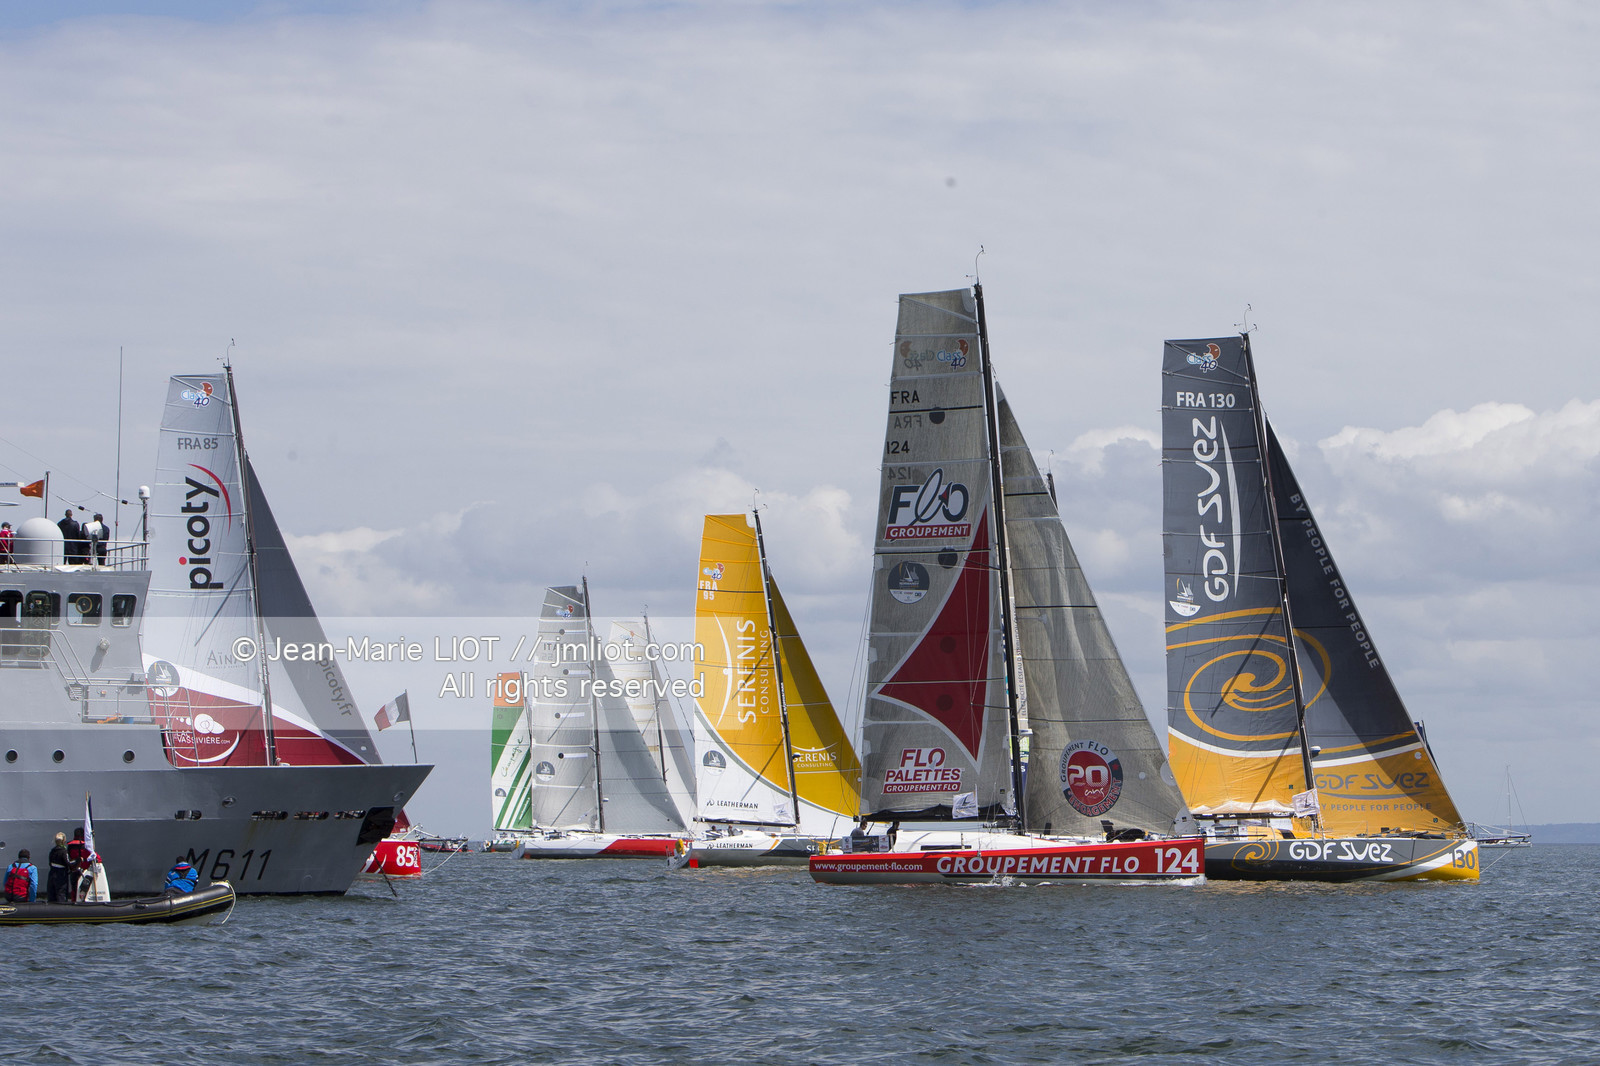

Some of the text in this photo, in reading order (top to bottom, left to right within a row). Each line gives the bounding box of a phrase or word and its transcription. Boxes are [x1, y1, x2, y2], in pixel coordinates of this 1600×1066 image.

[936, 350, 961, 361] Class
[951, 357, 967, 370] 40
[1200, 360, 1217, 372] 40
[181, 389, 205, 400] Class
[891, 391, 920, 404] FRA
[1176, 391, 1235, 408] FRA 130
[194, 397, 210, 408] 40
[177, 437, 218, 450] FRA 85
[886, 441, 910, 454] 124
[178, 476, 224, 590] picoty
[889, 526, 968, 537] GROUPEMENT
[700, 580, 718, 590] FRA
[1290, 493, 1380, 668] BY PEOPLE FOR PEOPLE
[737, 620, 756, 723] SERENIS
[760, 630, 769, 714] CONSULTING
[315, 657, 353, 716] picoty.fr
[1088, 741, 1109, 756] FLO
[900, 748, 945, 767] FLO
[885, 768, 961, 782] PALETTES
[1068, 765, 1109, 787] 20
[886, 783, 958, 792] GROUPEMENT FLO
[717, 801, 758, 809] LEATHERMAN
[1393, 803, 1432, 811] PEOPLE
[396, 845, 415, 867] 85
[936, 848, 1200, 874] GROUPEMENT FLO 124
[1452, 850, 1476, 870] 130
[814, 862, 923, 872] www.groupement-flo.com
